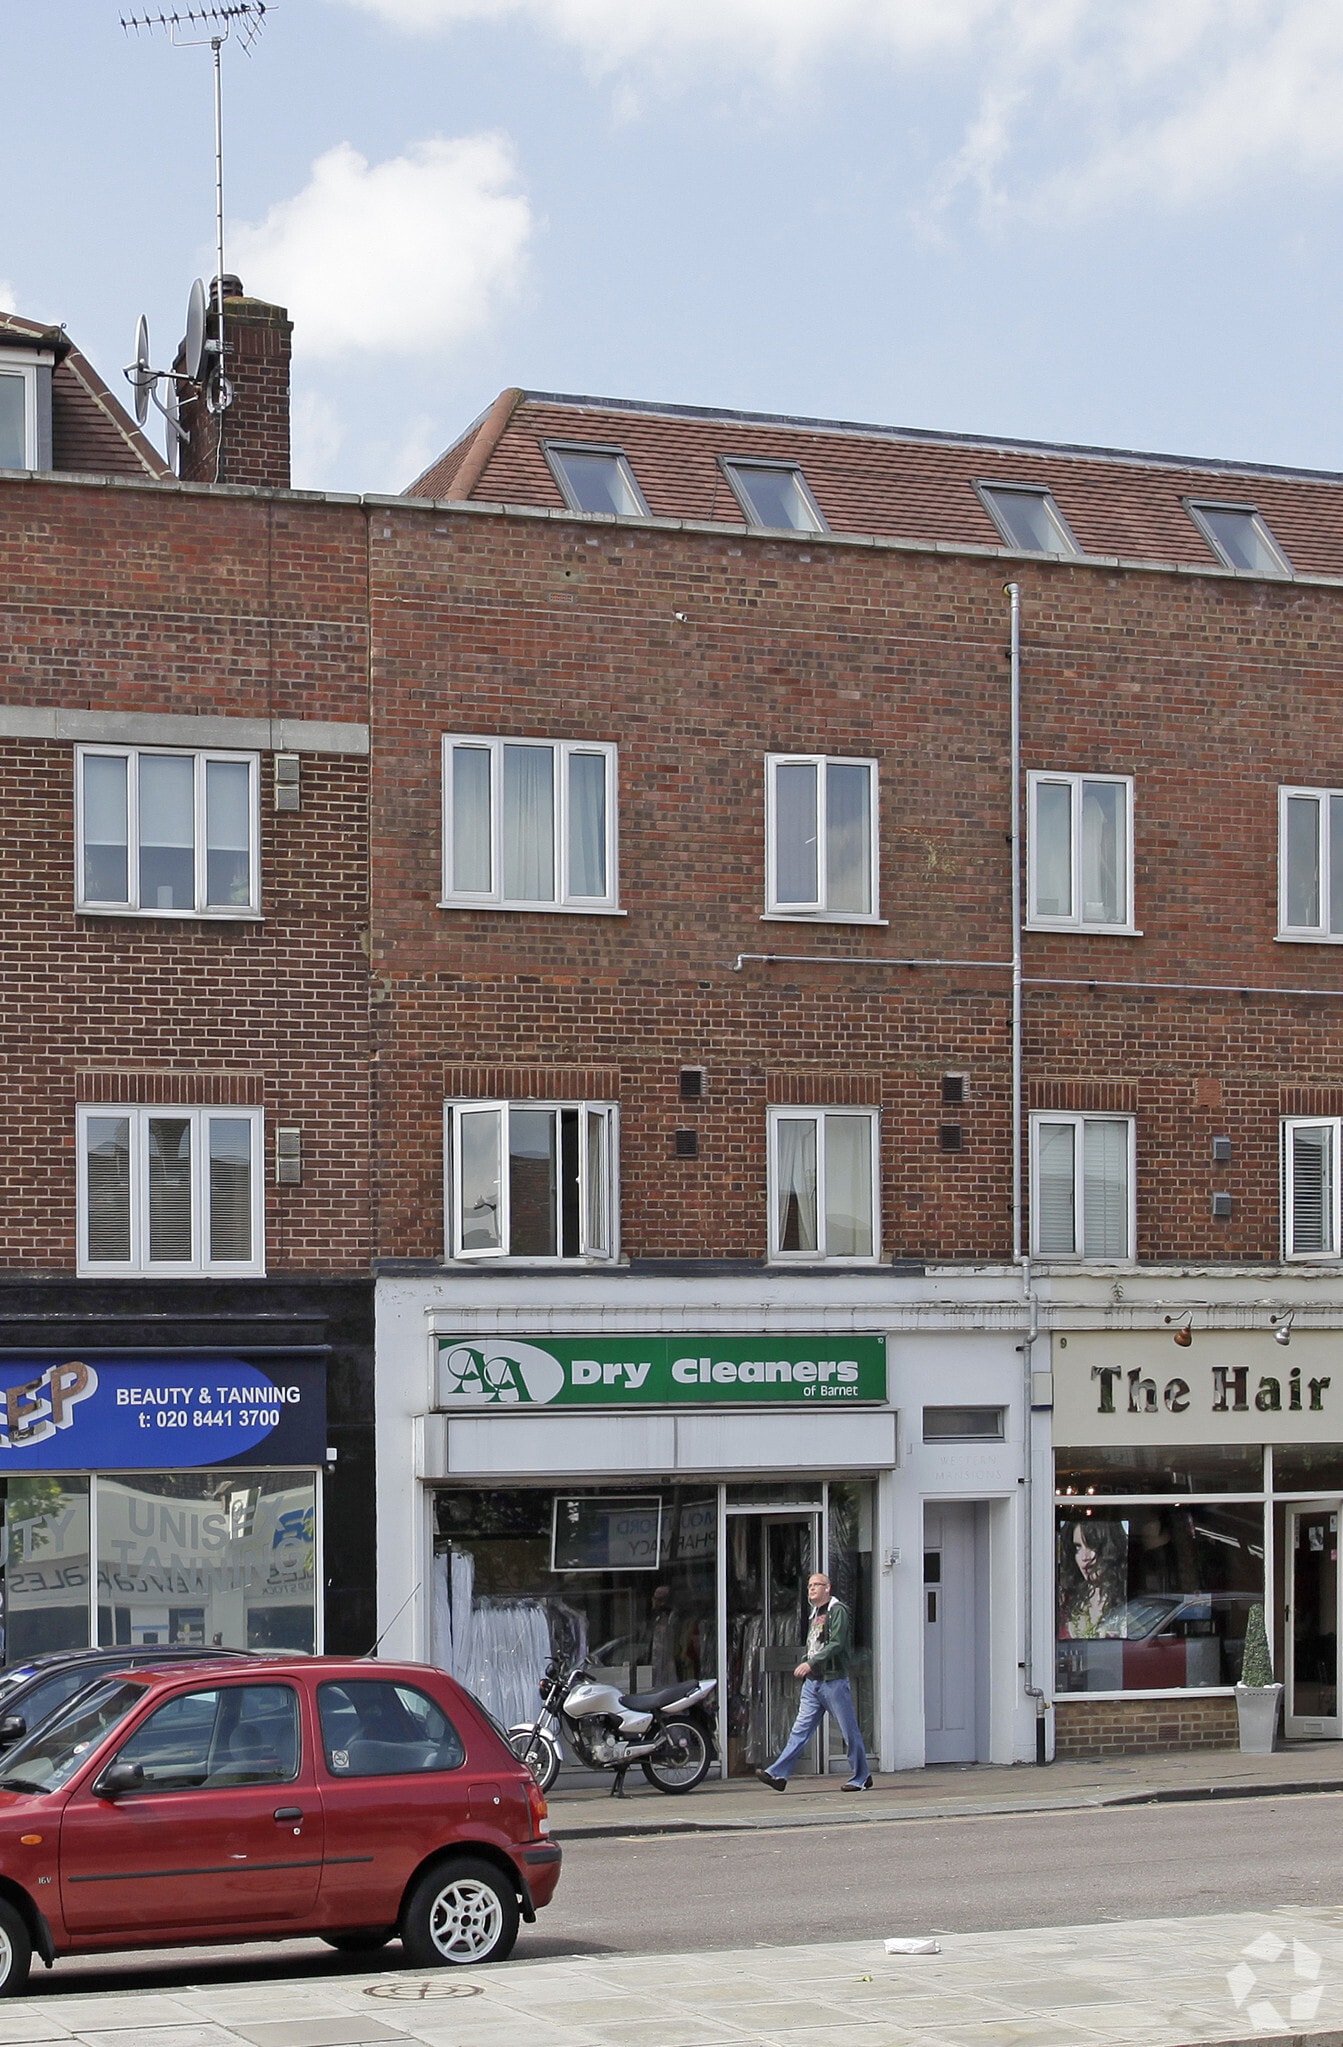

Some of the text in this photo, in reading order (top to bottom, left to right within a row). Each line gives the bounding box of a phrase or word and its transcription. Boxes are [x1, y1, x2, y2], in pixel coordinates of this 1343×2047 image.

[1060, 1338, 1068, 1348] 9
[571, 1358, 859, 1389] Dry Cleaners
[116, 1386, 301, 1405] BEAUTY & TANNING
[803, 1385, 859, 1396] of Barnet
[1091, 1365, 1331, 1413] The Hair
[0, 1361, 98, 1448] EP
[138, 1410, 280, 1428] t: 020 8441 3700
[940, 1455, 997, 1465] WESTERN
[935, 1470, 1002, 1480] MANSIONS
[128, 1496, 285, 1550] UNISEX
[111, 1538, 303, 1595] TANNING
